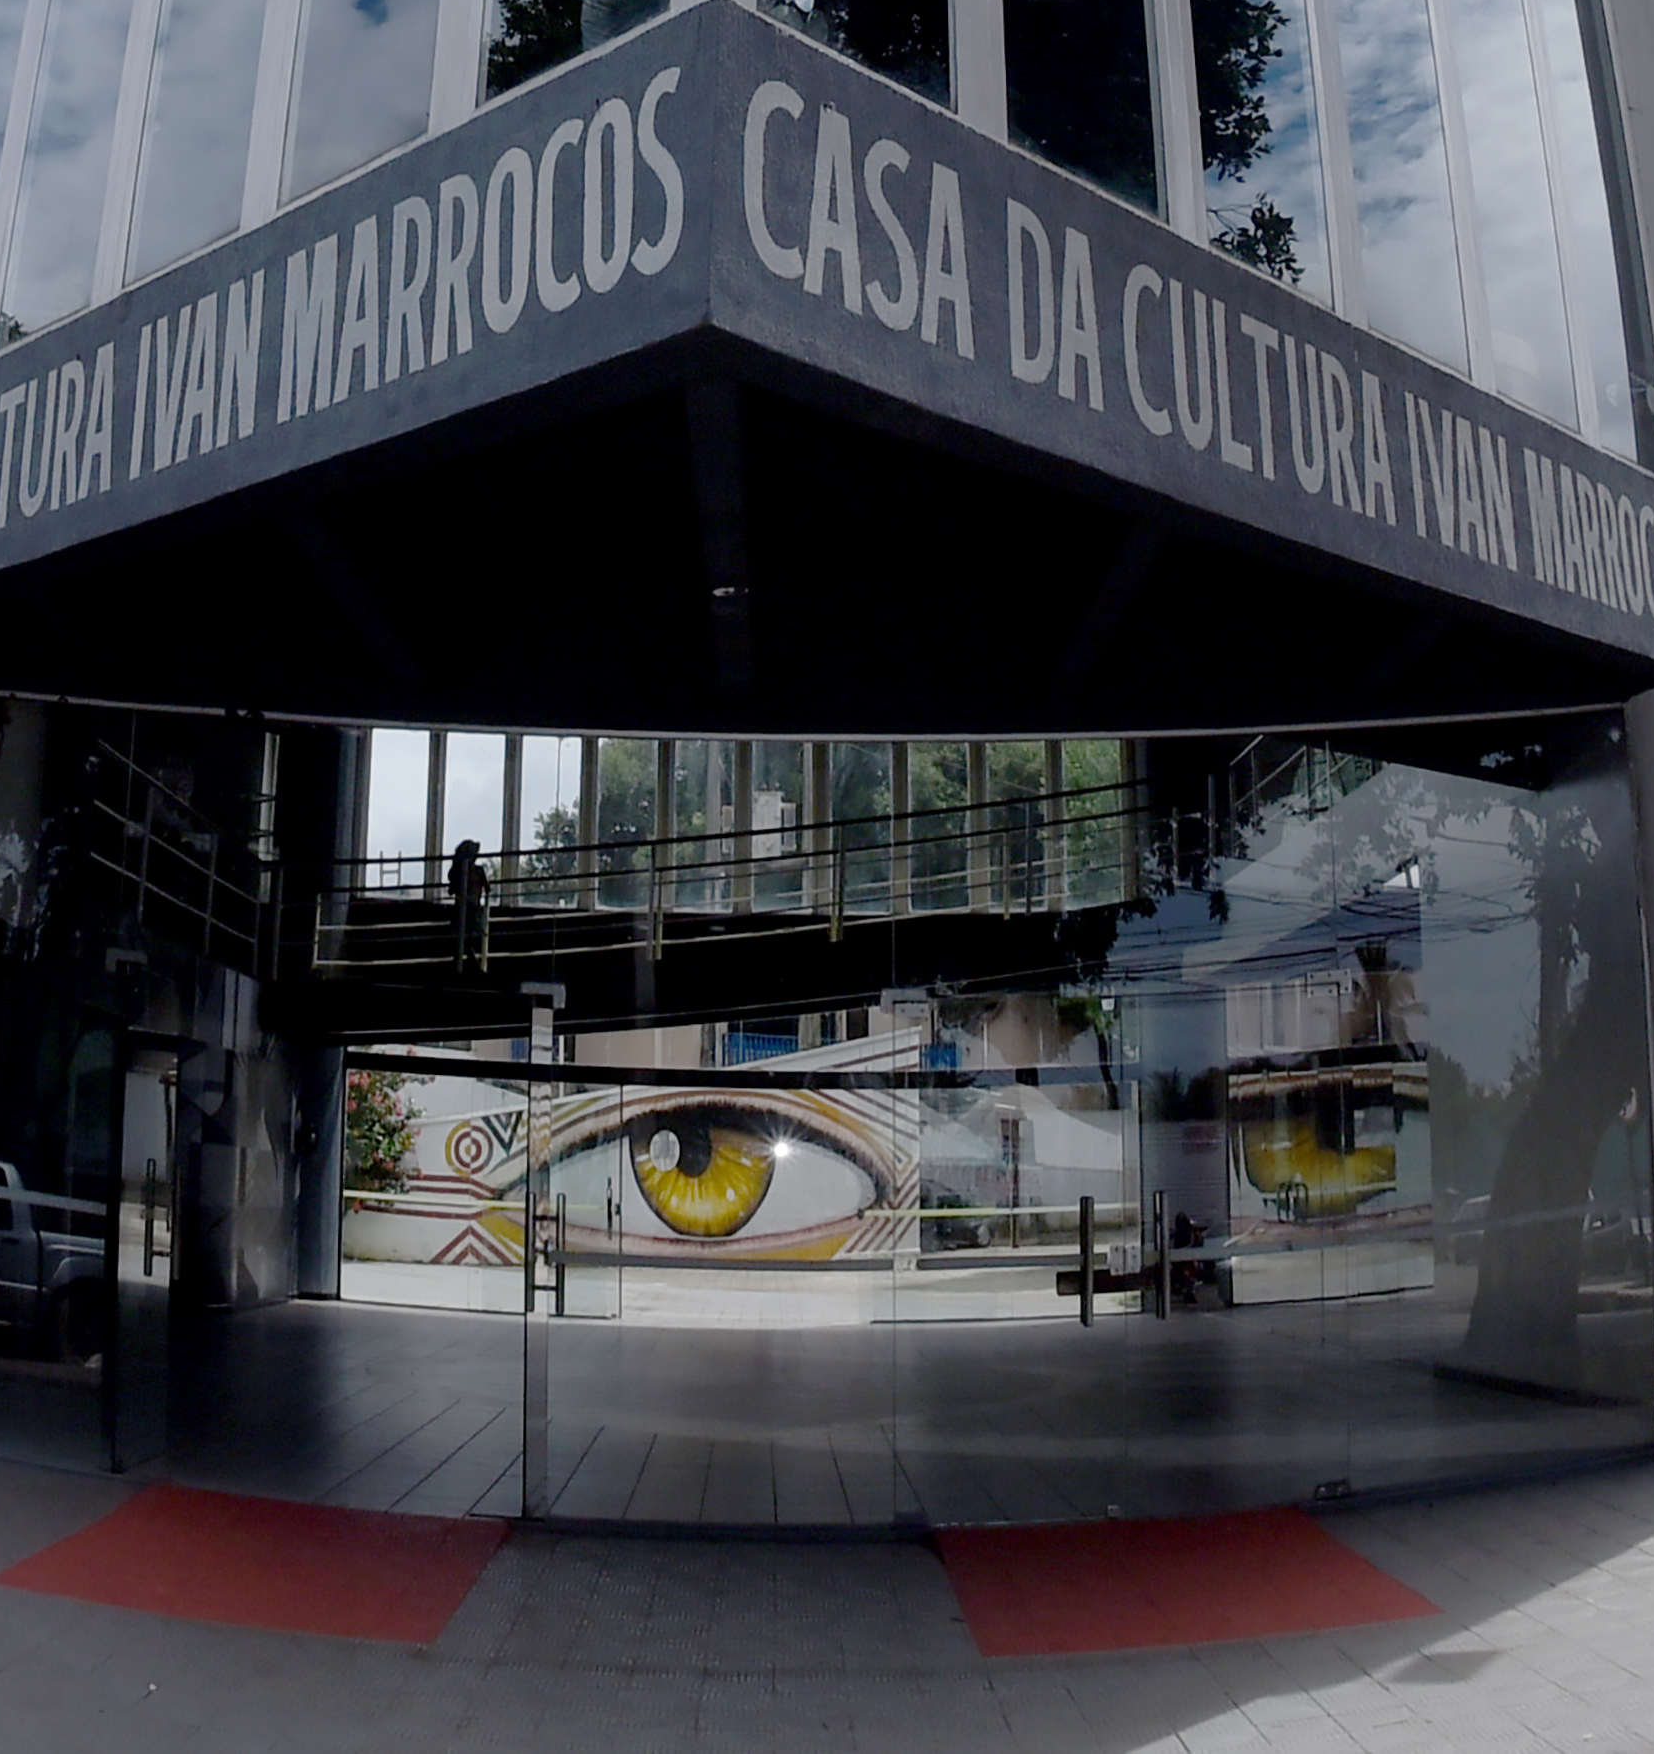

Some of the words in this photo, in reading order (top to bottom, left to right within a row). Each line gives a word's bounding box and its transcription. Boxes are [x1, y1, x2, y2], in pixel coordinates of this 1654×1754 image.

[128, 267, 265, 481] IVAN
[276, 66, 684, 425] MARROCOS
[743, 80, 975, 361] CASA
[1007, 197, 1105, 413] DA
[1122, 264, 1397, 527] CULTURA
[1404, 391, 1518, 572] IVAN
